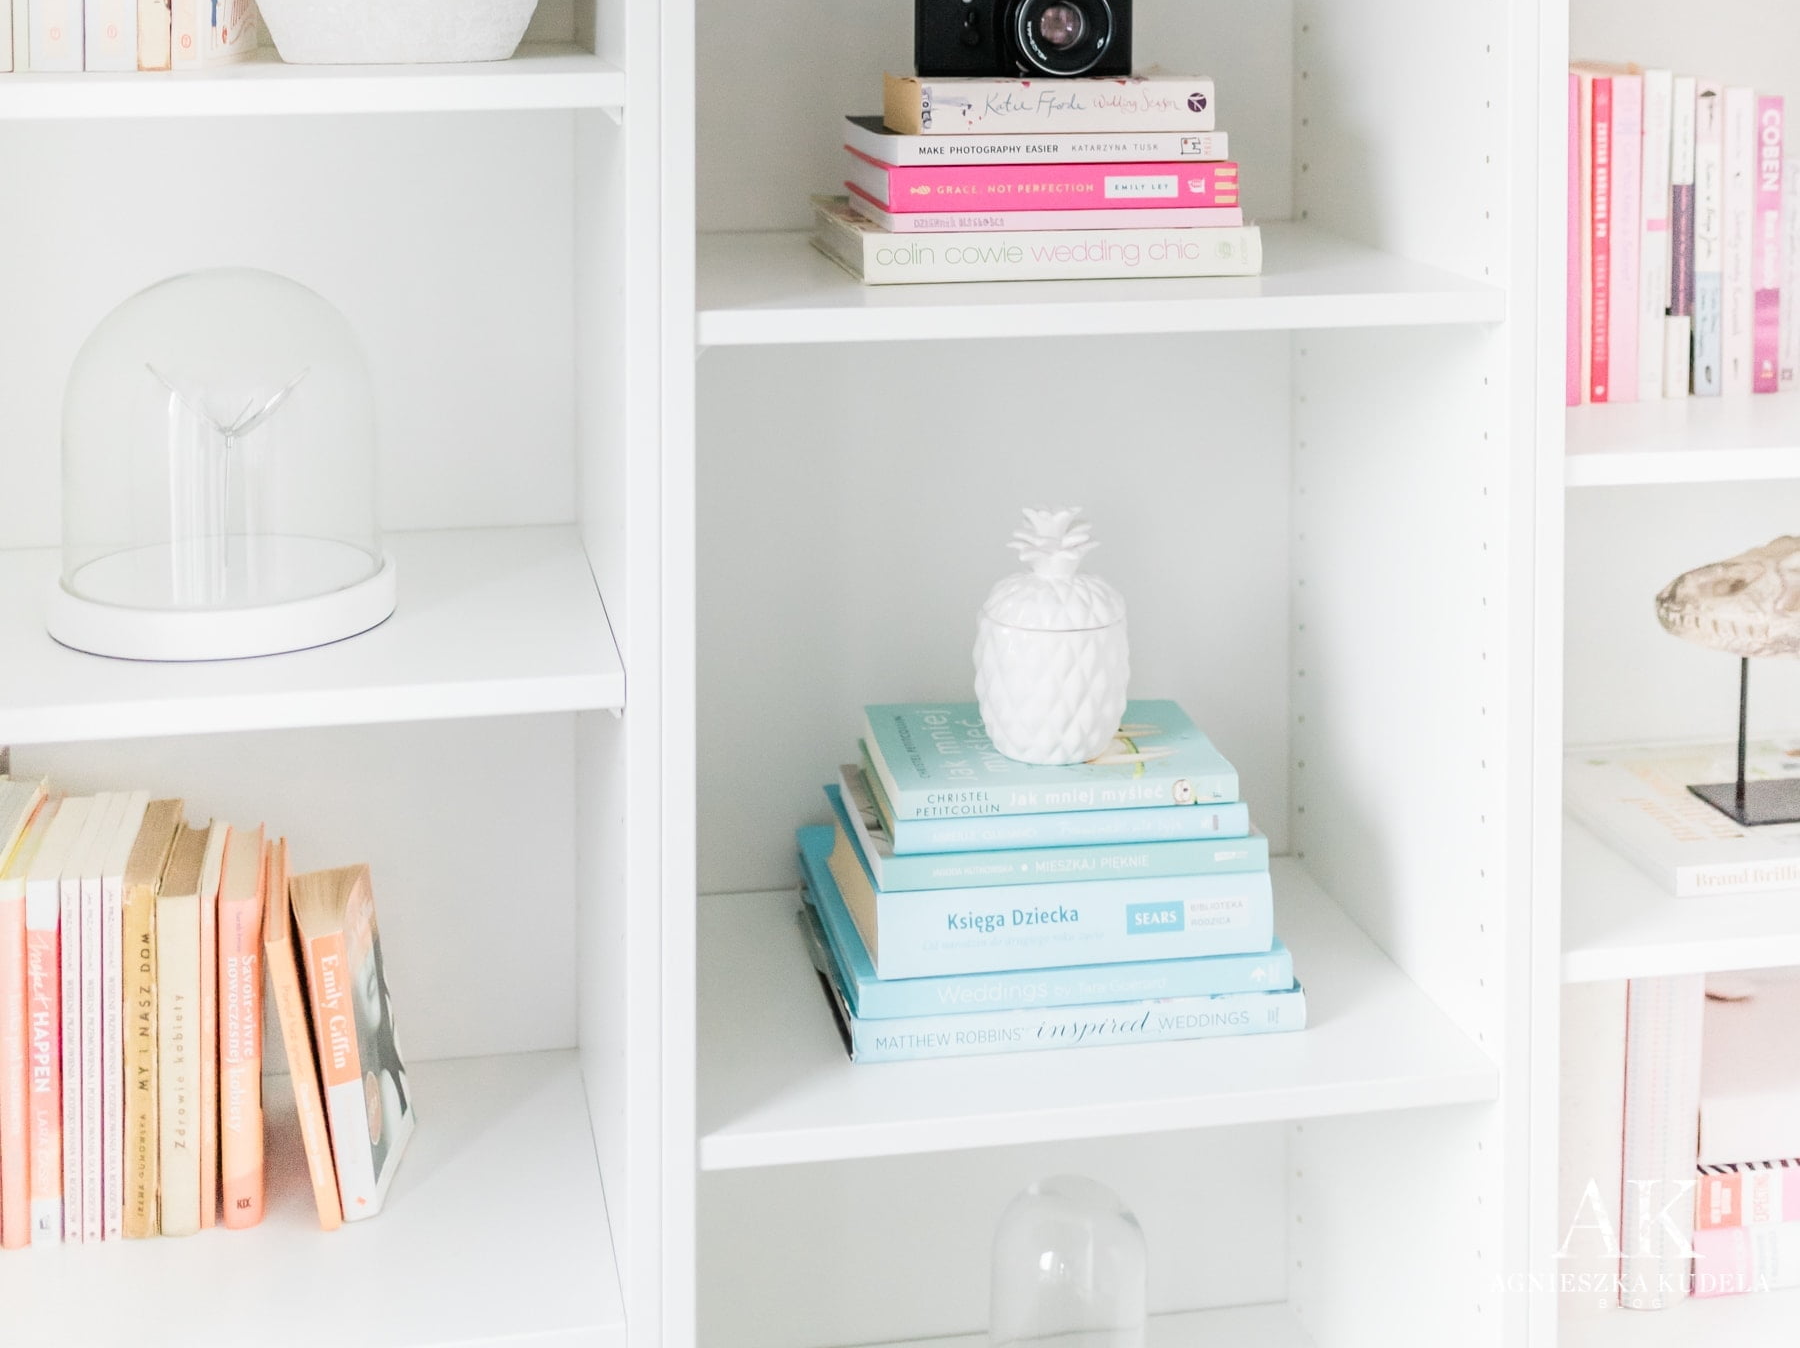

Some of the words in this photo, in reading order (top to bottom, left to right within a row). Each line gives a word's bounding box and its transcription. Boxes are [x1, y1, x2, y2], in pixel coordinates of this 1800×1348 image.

[918, 146, 945, 155] MAKE
[949, 145, 1022, 155] PHOTOGRAPHY
[1025, 144, 1059, 154] EASIER
[1070, 143, 1128, 153] KATARZYNA
[1133, 143, 1160, 152] TUSK
[1761, 109, 1781, 192] COBEN
[987, 185, 1013, 194] NOT
[1016, 183, 1095, 194] PERFECTION
[1114, 183, 1147, 191] EMILY
[1151, 182, 1170, 190] LEY
[875, 241, 936, 266] colin
[944, 240, 1024, 265] cowie
[1029, 238, 1142, 267] wedding
[1147, 237, 1201, 263] chic
[915, 709, 959, 755] mniej
[915, 803, 1000, 818] PETITCOLLIN
[927, 791, 989, 805] CHRISTEL
[1009, 790, 1041, 807] Jak
[1044, 787, 1096, 806] mniej
[1101, 783, 1165, 804] myśleć
[1034, 856, 1097, 874] MIESZKAJ
[1100, 854, 1150, 870] PIĘKNIE
[1695, 867, 1748, 888] Brand
[947, 910, 1005, 933] Księga
[1011, 905, 1080, 927] Dziecka
[1134, 911, 1177, 926] SEARS
[1190, 899, 1244, 913] BIBLIOTEKA
[140, 933, 150, 973] DOM
[320, 954, 342, 1010] Emily
[935, 980, 1048, 1005] Weddings
[1054, 985, 1072, 998] by
[139, 984, 150, 1037] NASZ
[225, 956, 243, 1064] nowoczesnej
[239, 954, 257, 1057] Savoir-vivre
[173, 993, 185, 1064] kobiety
[328, 1014, 350, 1070] Giffin
[875, 1032, 951, 1051] MATTHEW
[1034, 1010, 1152, 1042] inspired
[1156, 1010, 1250, 1032] WEDDINGS
[33, 1011, 51, 1093] HAPPEN
[138, 1066, 149, 1092] MY
[174, 1076, 186, 1150] Zdrowie
[227, 1066, 246, 1133] kobiety
[137, 1114, 147, 1179] GUMOWSKA
